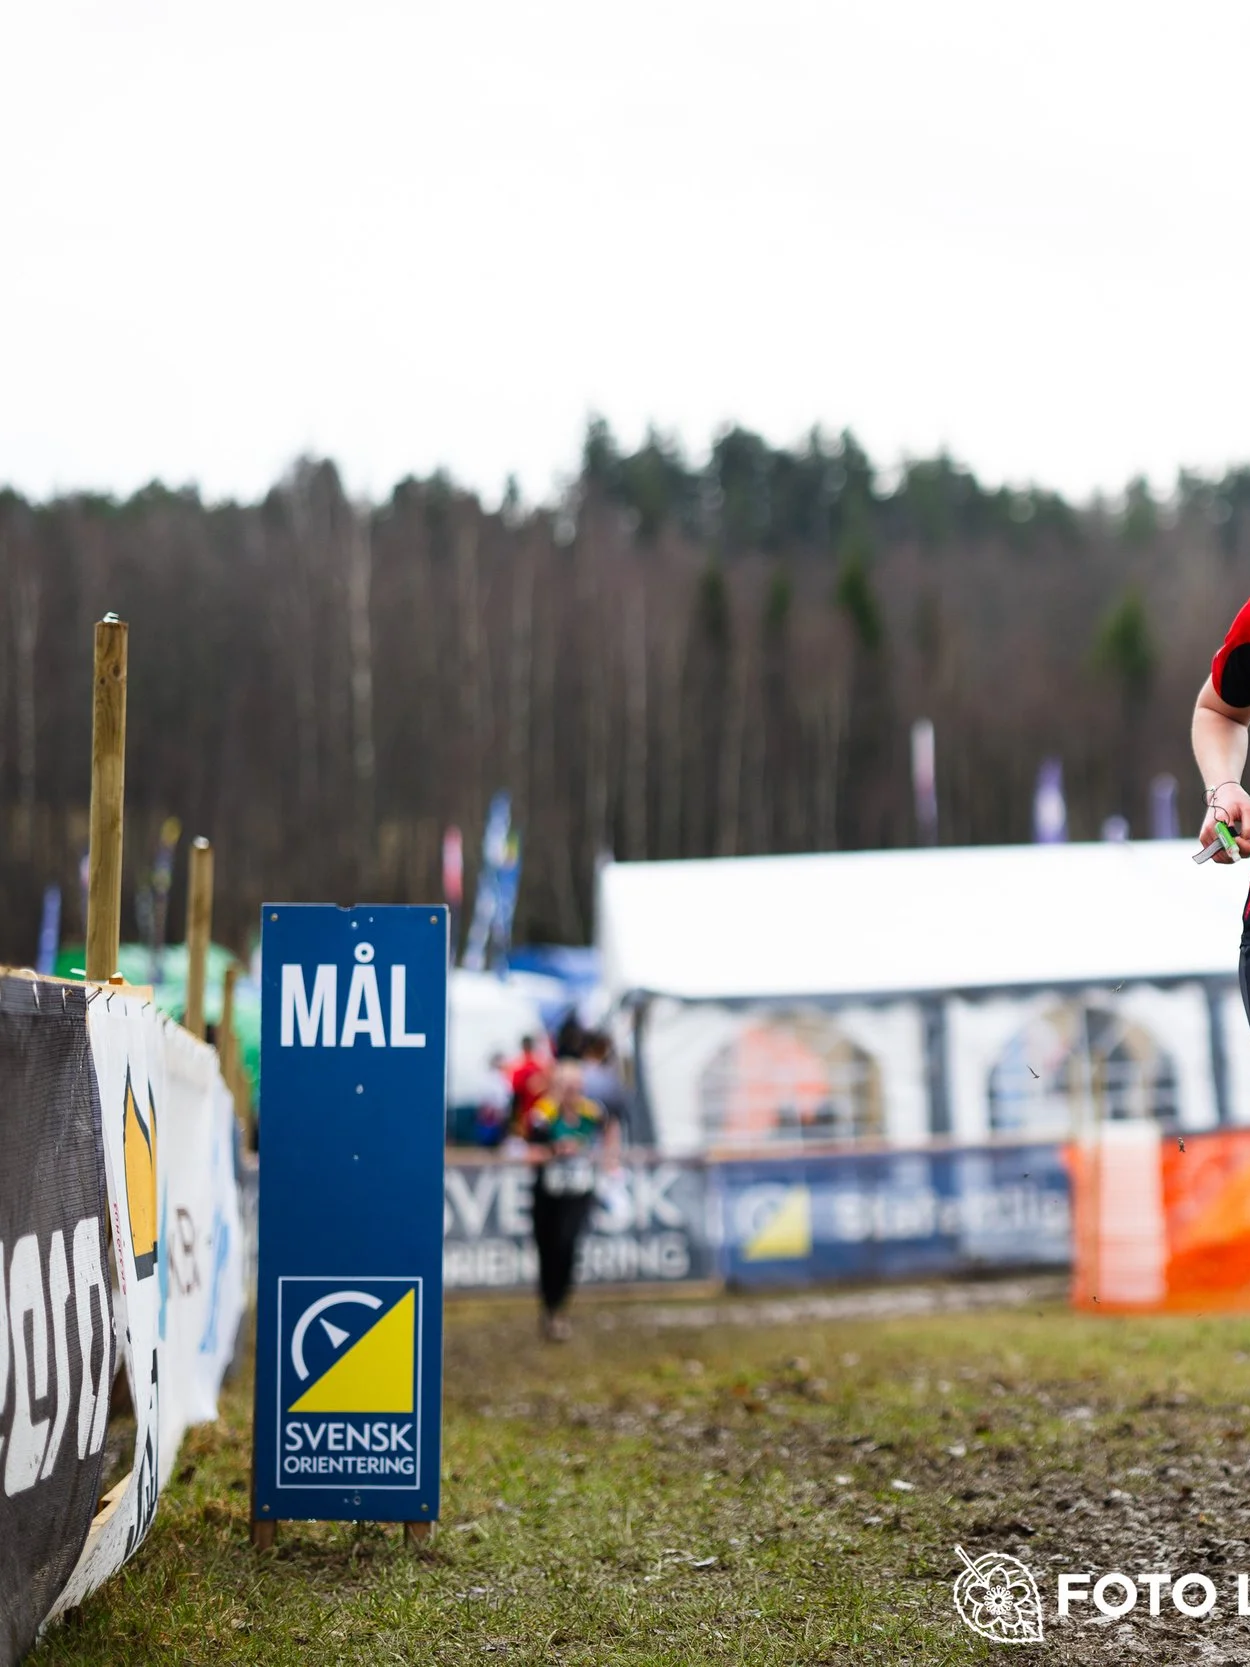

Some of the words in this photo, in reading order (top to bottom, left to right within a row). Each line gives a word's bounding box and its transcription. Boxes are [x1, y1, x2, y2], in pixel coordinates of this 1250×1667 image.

[281, 942, 426, 1047] MÅL
[285, 1421, 414, 1452] SVENSK
[283, 1455, 415, 1475] ORIENTERING
